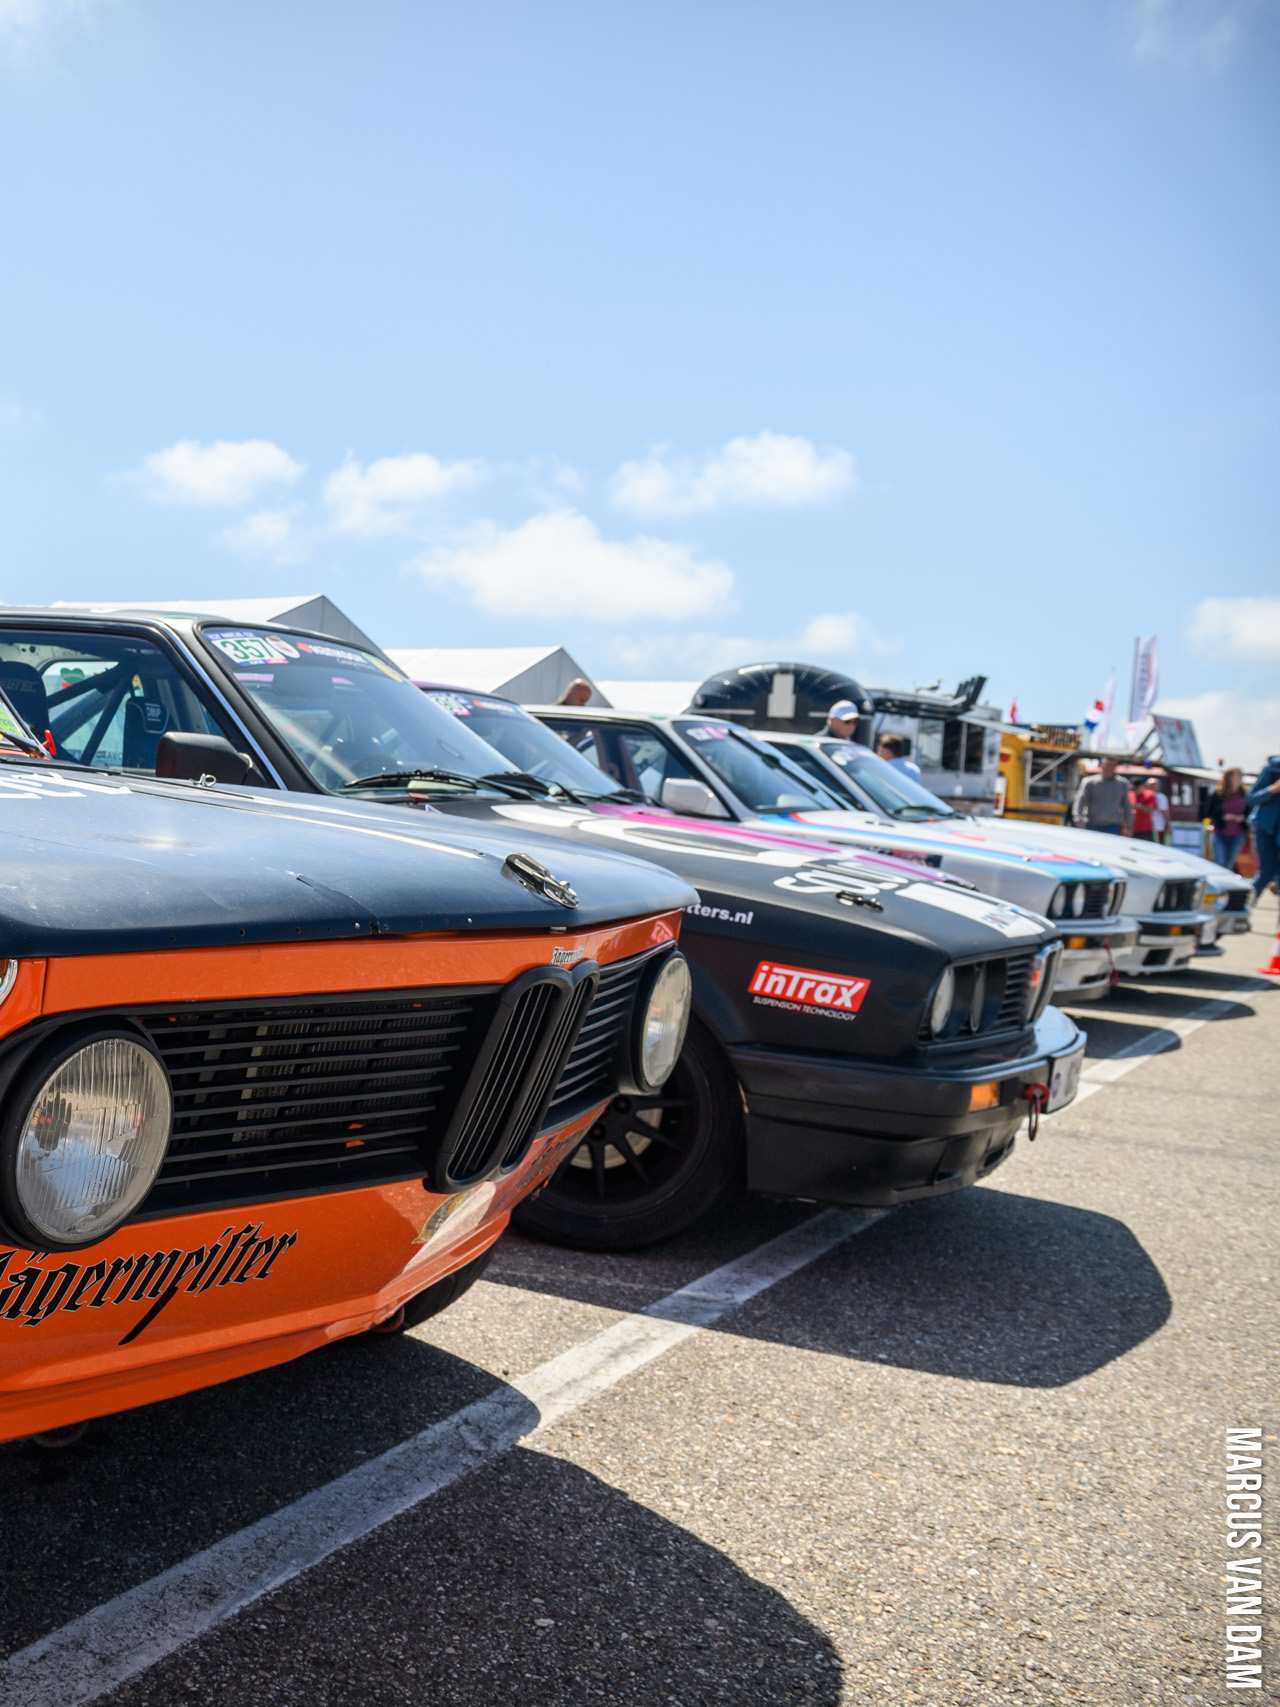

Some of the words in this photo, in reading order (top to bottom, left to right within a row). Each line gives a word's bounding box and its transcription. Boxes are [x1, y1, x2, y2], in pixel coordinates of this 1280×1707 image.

[220, 639, 273, 660] 357
[752, 996, 801, 1012] SUSPENSION
[802, 1004, 856, 1021] TECHNOLOGY
